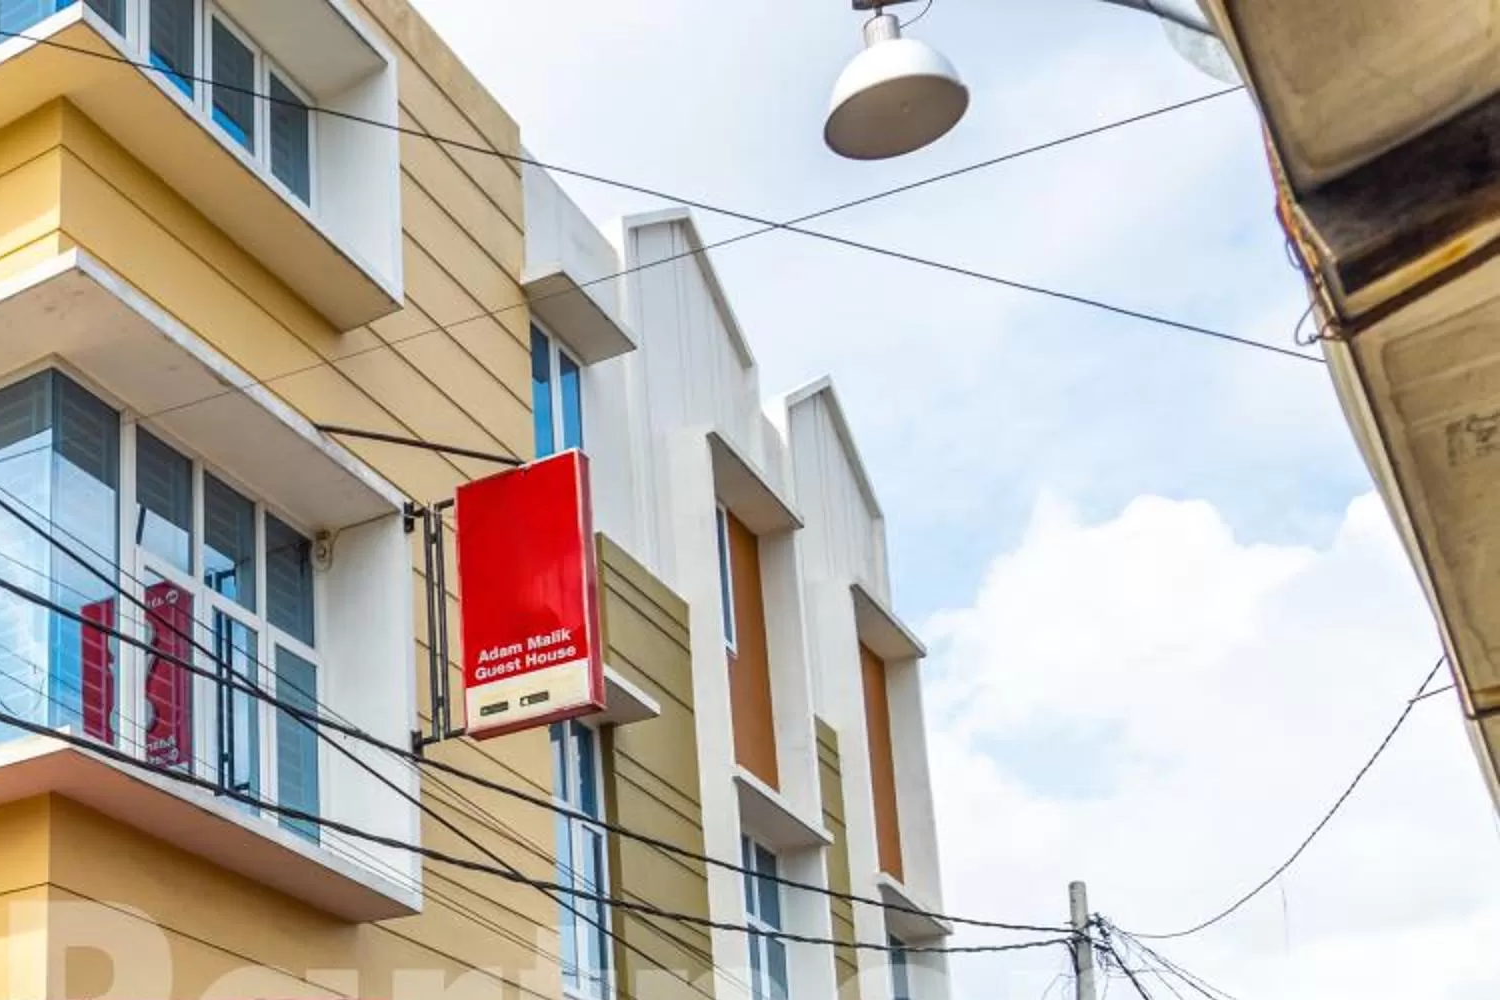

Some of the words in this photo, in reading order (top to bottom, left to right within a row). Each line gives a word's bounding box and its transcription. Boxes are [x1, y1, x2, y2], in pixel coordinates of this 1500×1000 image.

[475, 658, 521, 680] Guest
[525, 646, 577, 667] House
[478, 642, 523, 664] Adam
[527, 628, 572, 650] Malik
